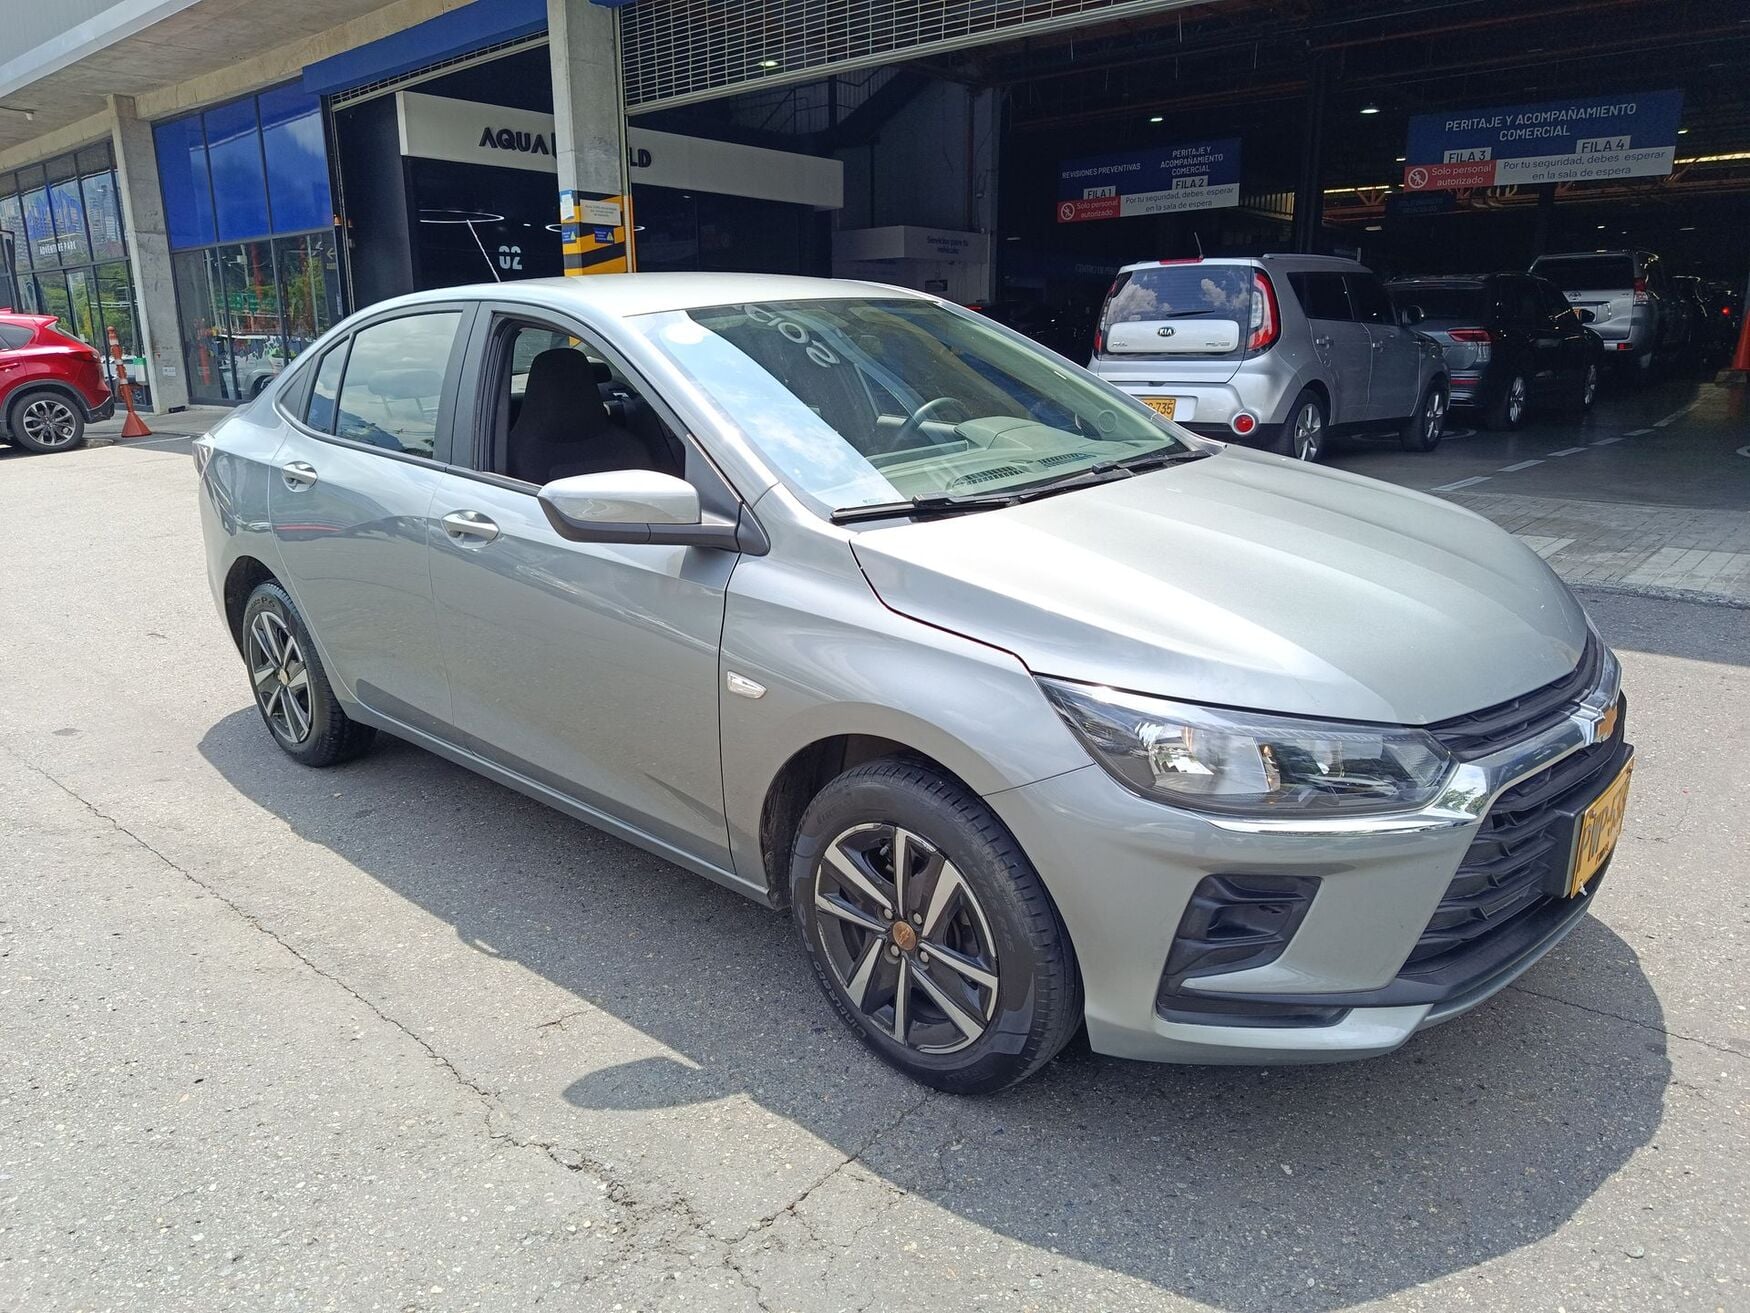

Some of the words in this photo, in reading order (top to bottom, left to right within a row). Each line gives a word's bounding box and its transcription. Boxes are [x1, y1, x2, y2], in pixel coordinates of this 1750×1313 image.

[1445, 115, 1502, 132] PERITAJE
[1506, 115, 1515, 126] Y
[1516, 103, 1637, 125] ACOMPAÑAMIENTO
[1499, 125, 1571, 141] COMERCIAL
[478, 126, 549, 155] AQUA
[1581, 140, 1612, 154] FILA
[1615, 139, 1625, 151] 4
[1172, 147, 1205, 158] PERITAJE
[1448, 152, 1477, 164] FILA
[1479, 150, 1487, 161] 3
[1503, 160, 1520, 170] Por
[1521, 160, 1531, 169] tu
[1532, 155, 1585, 170] seguridad,
[1587, 152, 1619, 164] debes
[1624, 151, 1665, 164] esperar
[1062, 168, 1097, 179] REVISIONES
[1098, 162, 1141, 175] PREVENTIVAS
[1171, 165, 1210, 176] COMERCIAL
[1431, 166, 1451, 176] Solo
[1453, 164, 1492, 177] personal
[1532, 172, 1545, 181] en
[1547, 169, 1556, 180] la
[1557, 168, 1579, 180] sala
[1581, 167, 1594, 178] de
[1596, 166, 1631, 180] espera
[1175, 180, 1195, 190] FILA
[1196, 178, 1204, 188] 2
[1437, 175, 1484, 187] autorizado
[1087, 189, 1106, 200] FILA
[1126, 195, 1138, 204] Por
[1182, 189, 1204, 200] debes
[1206, 186, 1234, 198] esperar
[1076, 201, 1090, 210] Solo
[1091, 199, 1119, 209] personal
[1162, 203, 1177, 211] sala
[1178, 201, 1187, 210] de
[1188, 200, 1212, 211] espera
[1081, 209, 1113, 218] autorizado
[498, 245, 523, 270] 02
